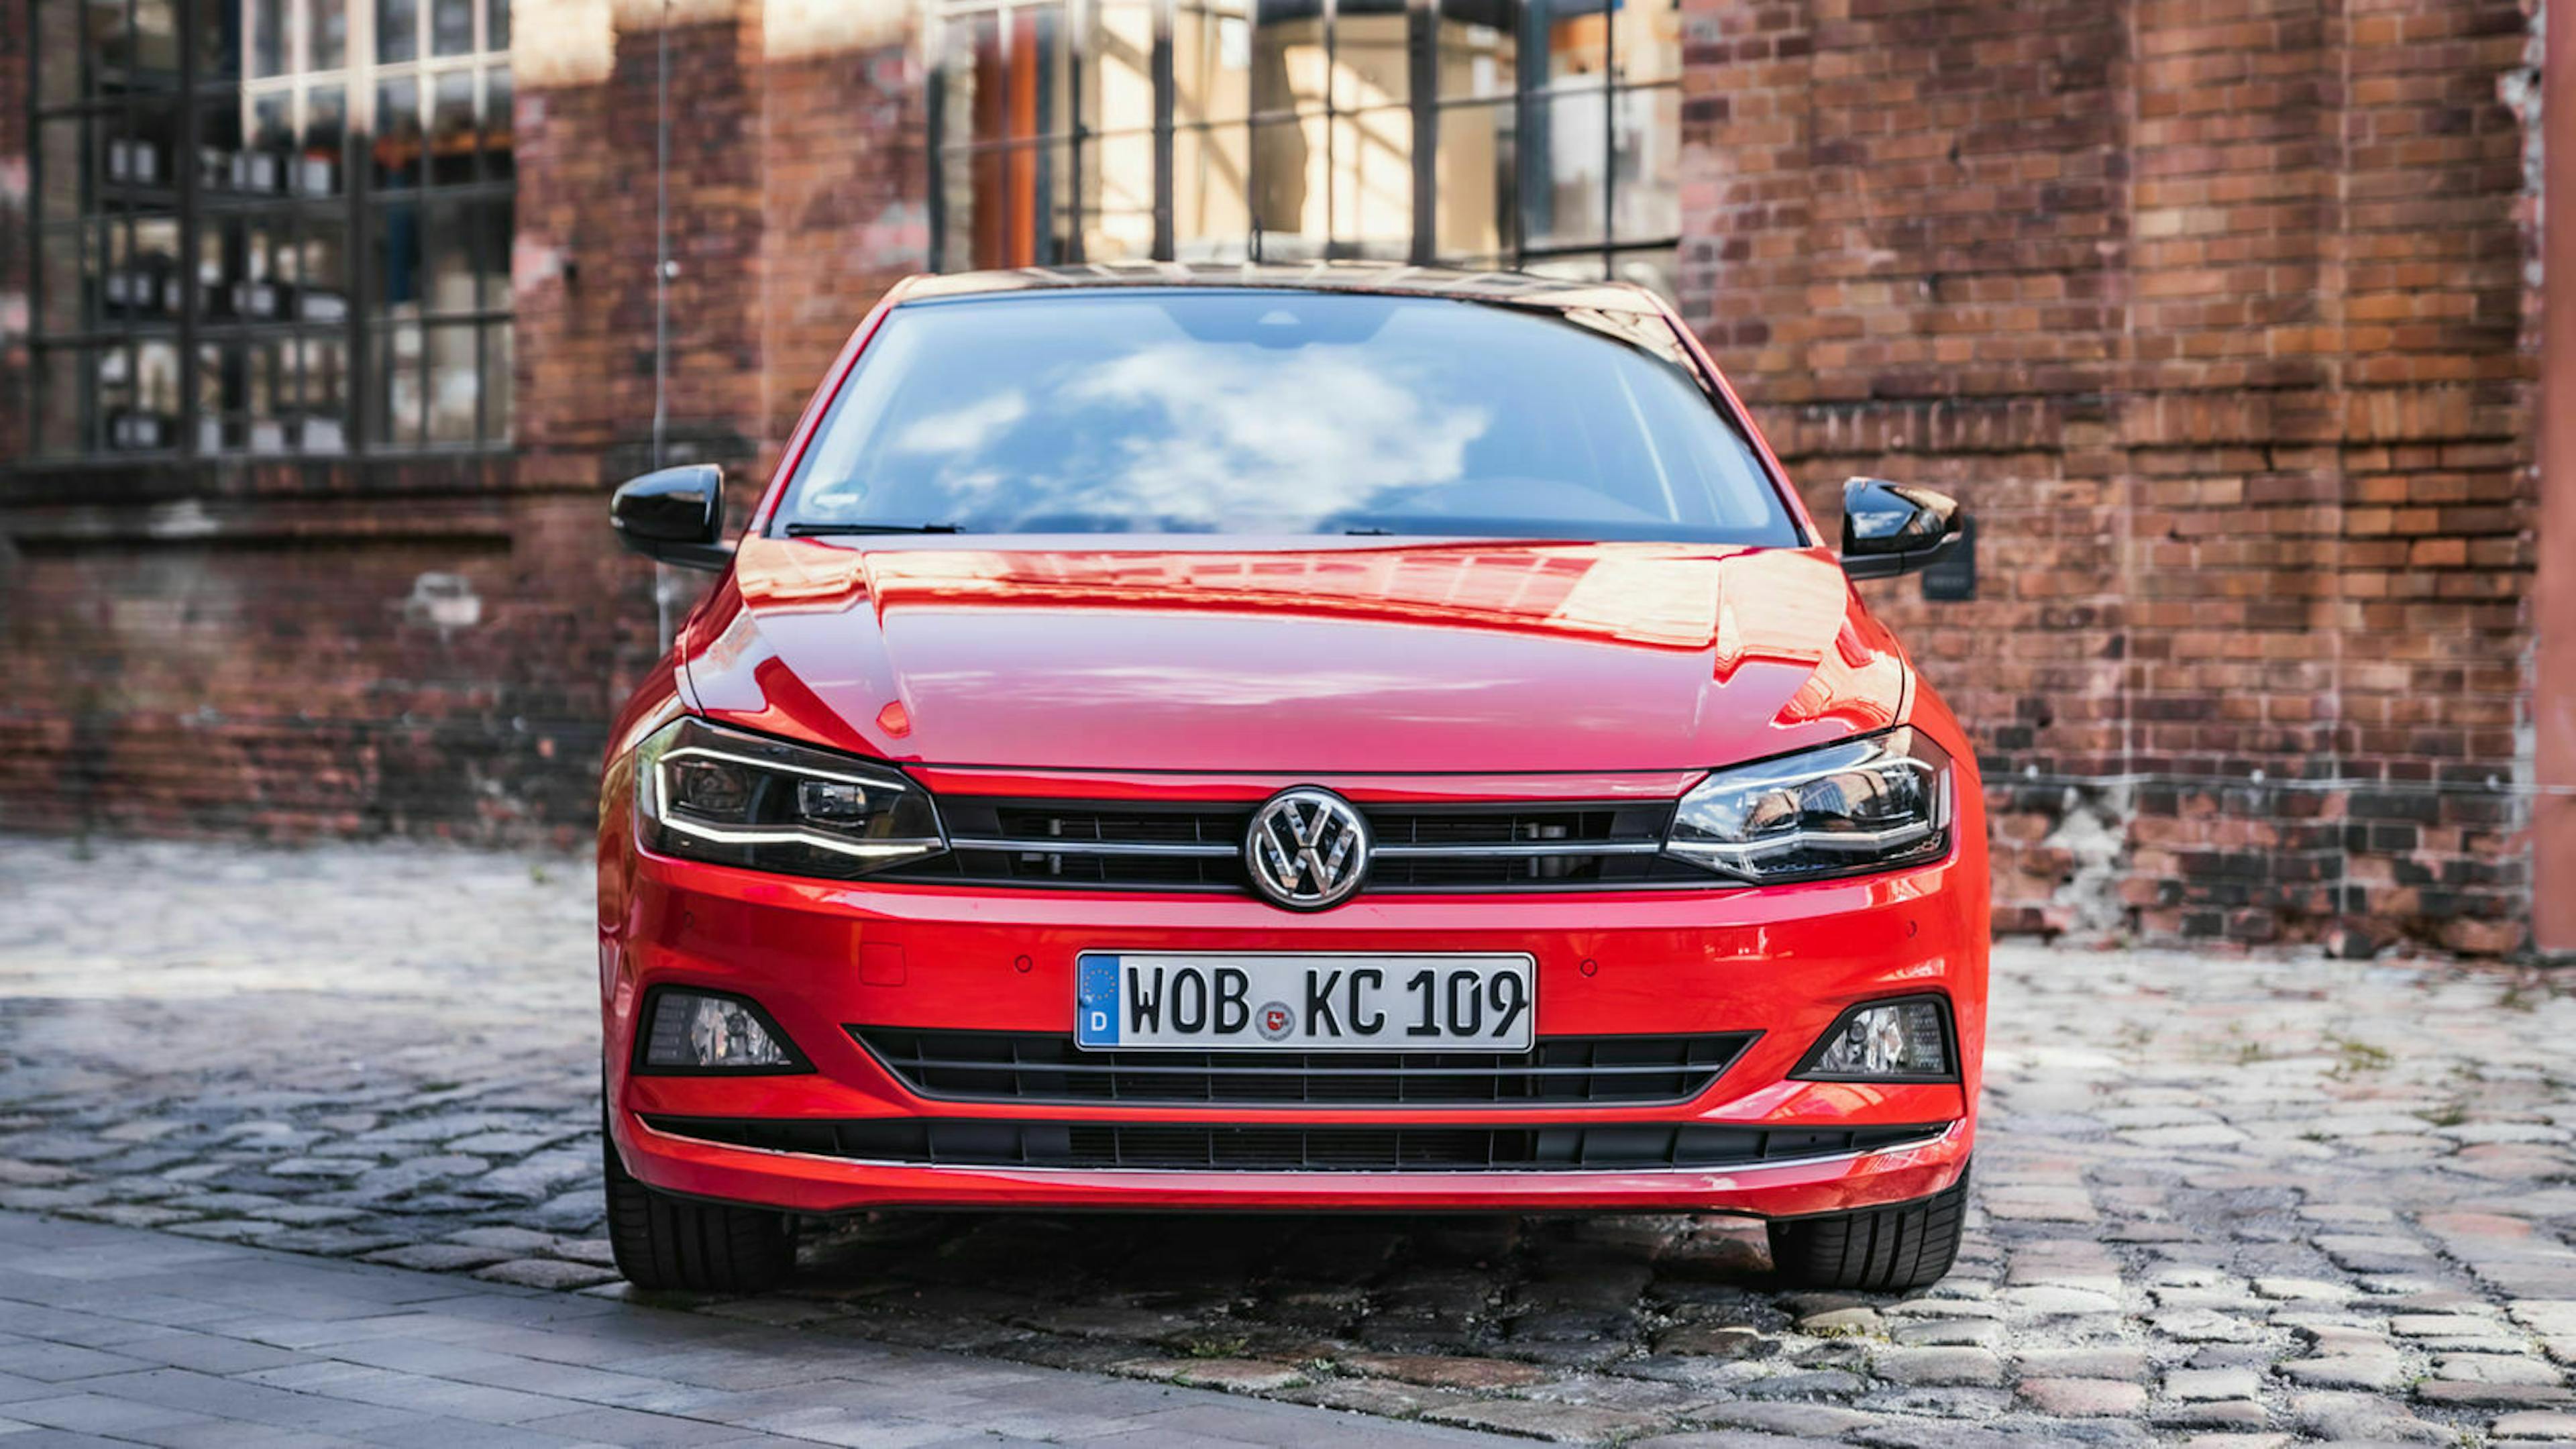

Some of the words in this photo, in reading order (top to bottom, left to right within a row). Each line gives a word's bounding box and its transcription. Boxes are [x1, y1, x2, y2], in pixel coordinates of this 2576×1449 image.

[1256, 796, 1359, 899] VW
[1092, 1012, 1108, 1031] D
[1128, 967, 1249, 1034] WOB
[1305, 969, 1385, 1036] KC
[1406, 970, 1527, 1037] 109
